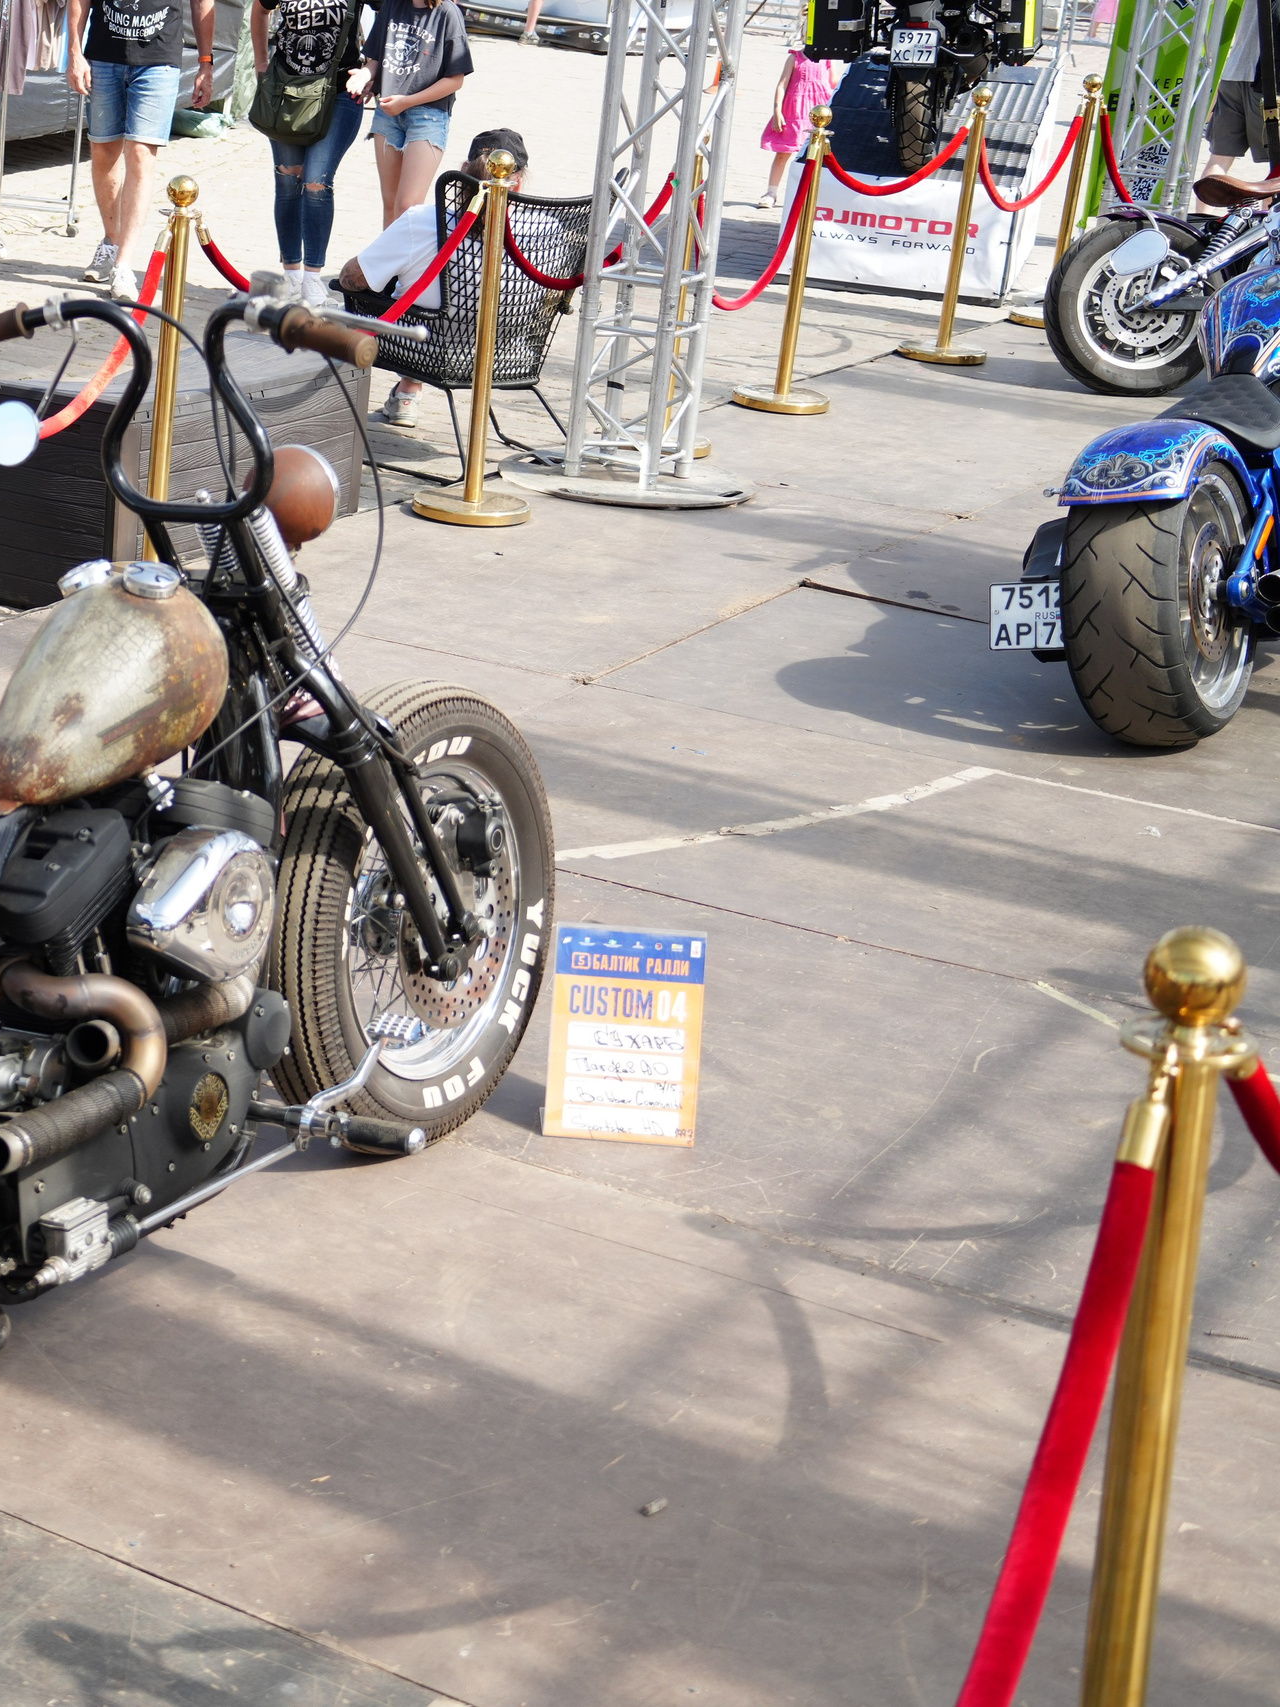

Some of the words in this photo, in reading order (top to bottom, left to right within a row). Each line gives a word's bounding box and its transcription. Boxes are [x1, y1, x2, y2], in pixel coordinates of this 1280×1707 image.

[132, 6, 170, 28] MACHINE
[109, 22, 132, 37] BROKEN
[133, 26, 156, 37] LEGEND
[898, 32, 932, 44] 5977
[917, 50, 932, 61] 77
[892, 239, 975, 255] FORWAD
[1034, 611, 1056, 620] RUS
[592, 953, 641, 974] БАЛТИК
[646, 957, 691, 978] РАЛЛИ
[569, 983, 654, 1021] CUSTOM
[656, 988, 688, 1024] 04
